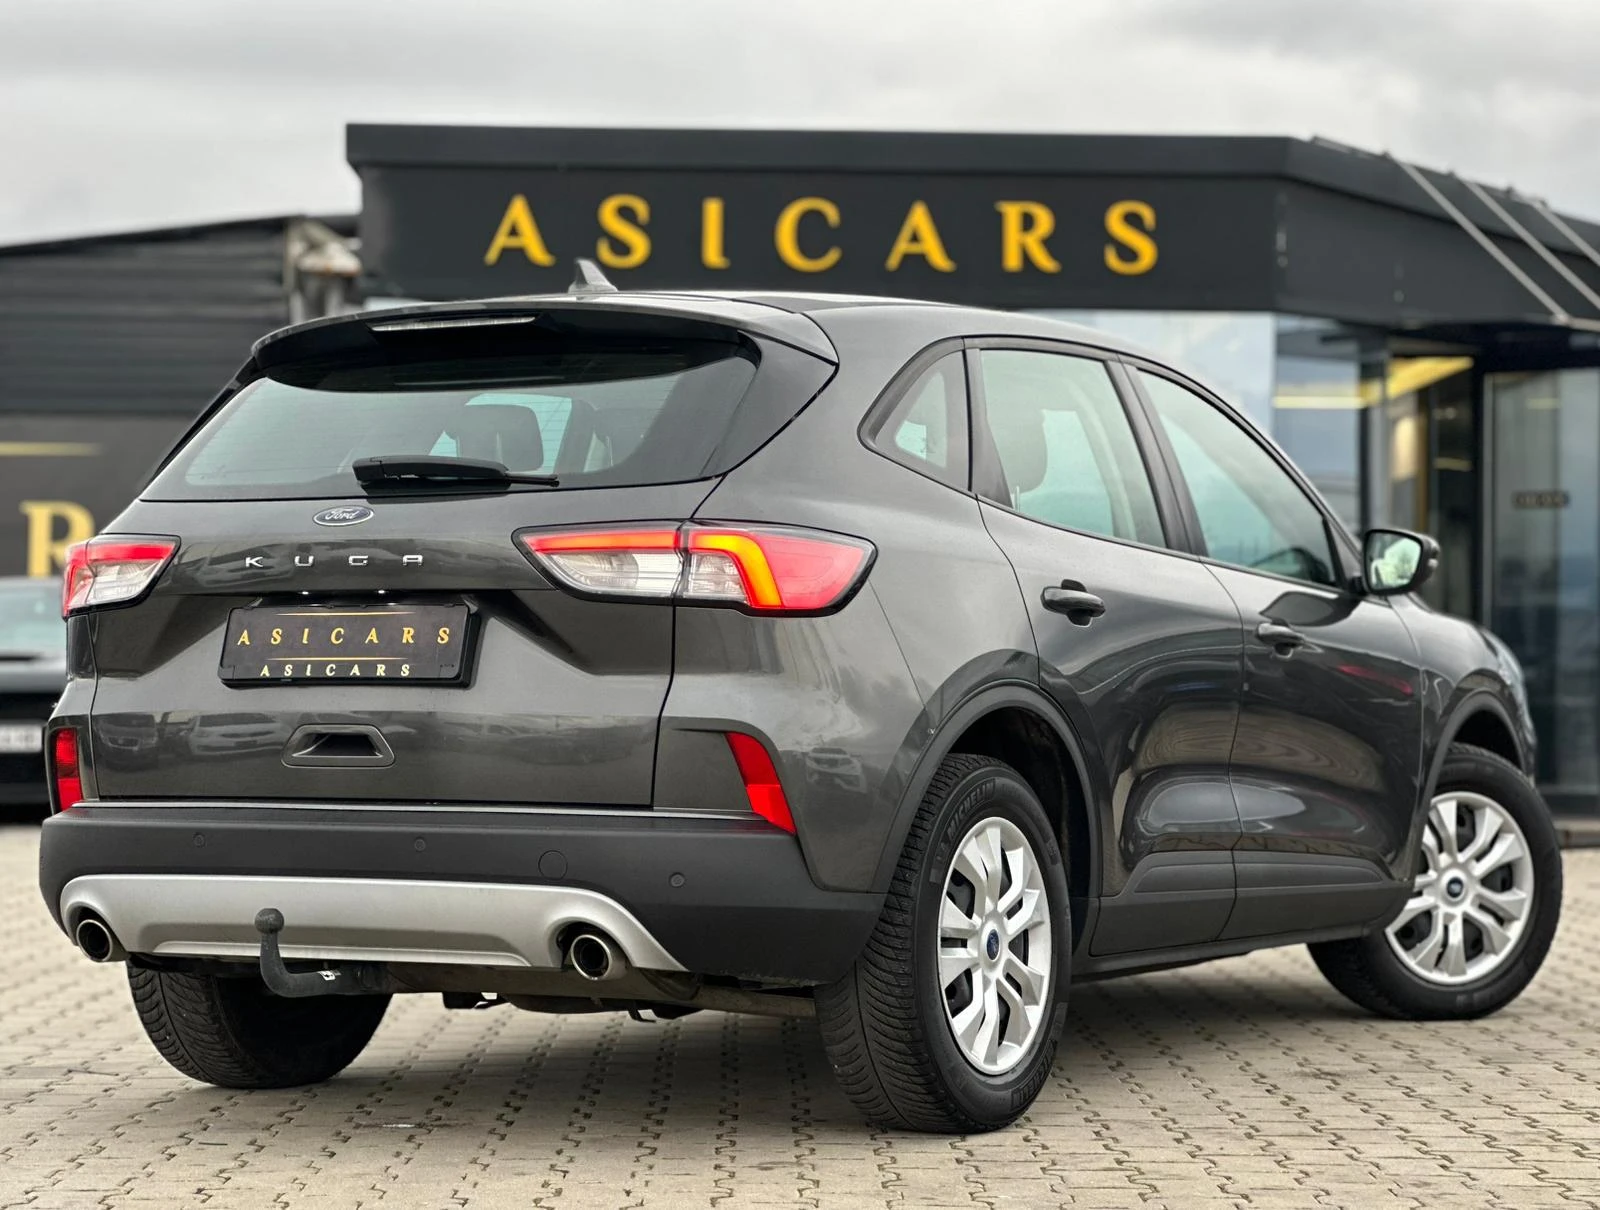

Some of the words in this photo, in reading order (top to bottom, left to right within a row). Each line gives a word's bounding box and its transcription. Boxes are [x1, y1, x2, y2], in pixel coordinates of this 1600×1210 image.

[484, 194, 1160, 275] ASICARS
[245, 554, 424, 567] KUGA
[237, 627, 451, 646] ASICARS
[259, 663, 411, 678] ASICARS
[946, 780, 996, 841] MICHELIN
